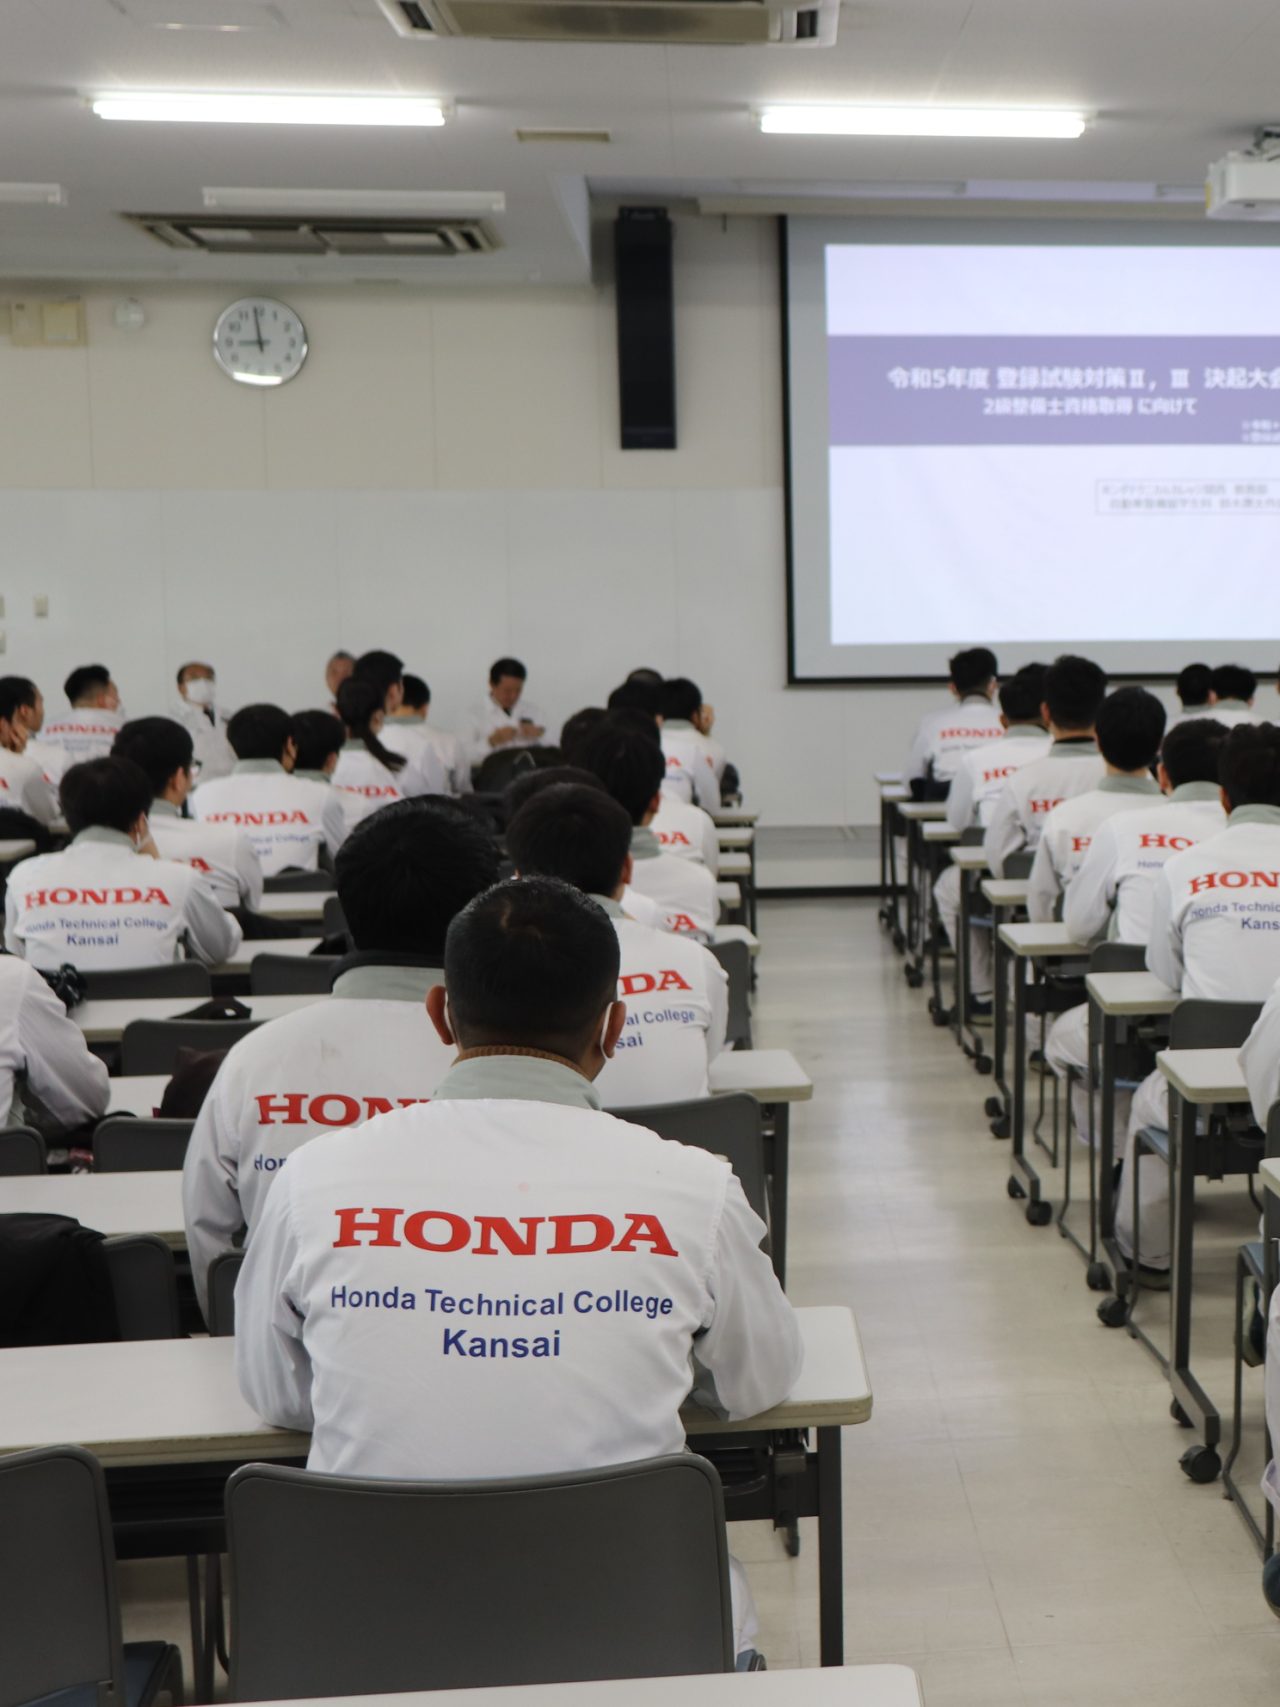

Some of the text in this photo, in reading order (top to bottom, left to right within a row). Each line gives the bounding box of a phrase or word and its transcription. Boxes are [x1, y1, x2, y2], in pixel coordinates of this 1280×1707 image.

[24, 886, 171, 911] HONDA
[58, 917, 120, 931] Technical
[66, 933, 120, 946] Kansai
[643, 1008, 695, 1024] College
[616, 1032, 643, 1049] sai
[333, 1207, 679, 1258] HONDA
[331, 1285, 674, 1319] Honda Technical College
[443, 1328, 561, 1358] Kansai
